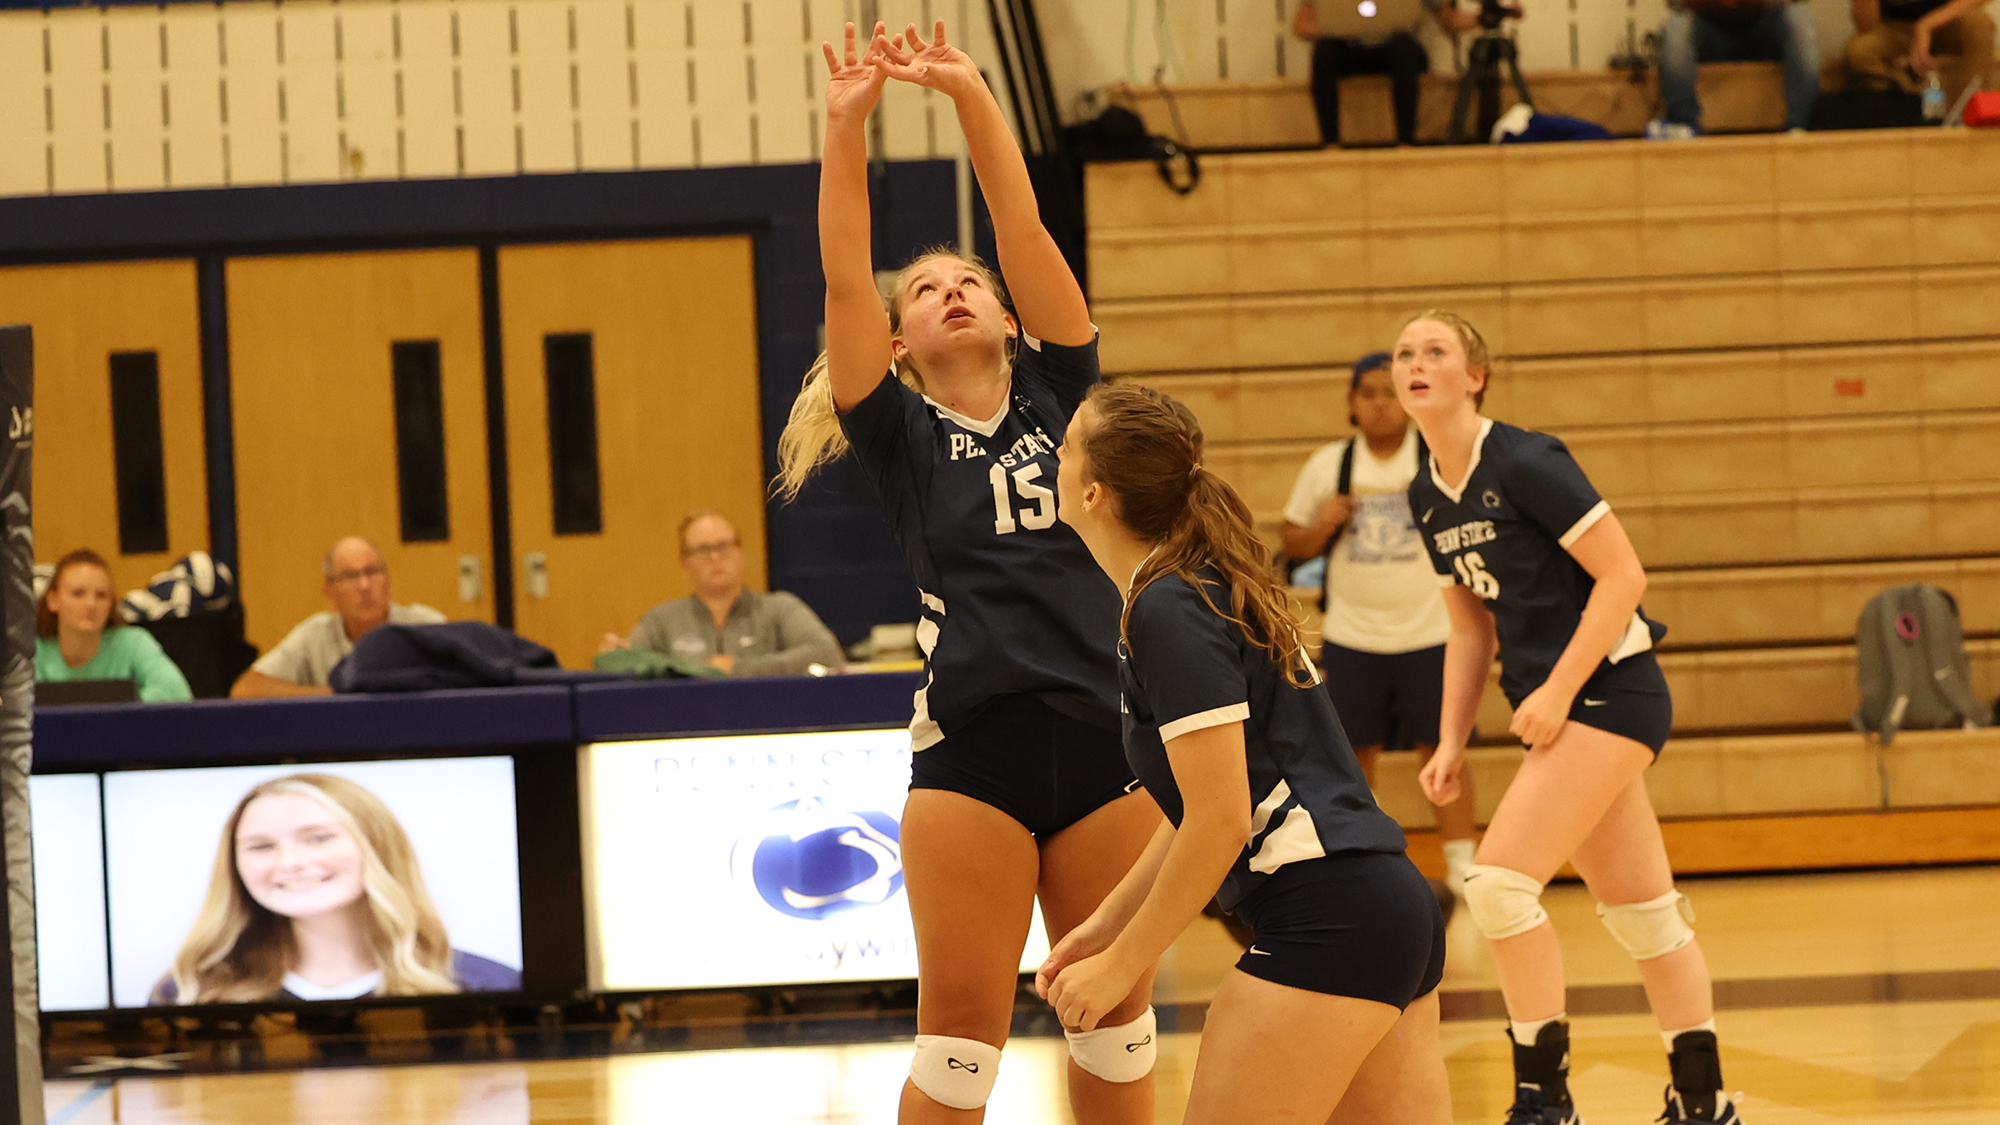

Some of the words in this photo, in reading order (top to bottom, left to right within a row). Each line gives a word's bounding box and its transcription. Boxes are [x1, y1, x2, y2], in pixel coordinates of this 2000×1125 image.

[949, 433, 991, 461] PE
[988, 461, 1057, 535] 15
[1453, 550, 1501, 601] 16
[820, 747, 911, 787] ST
